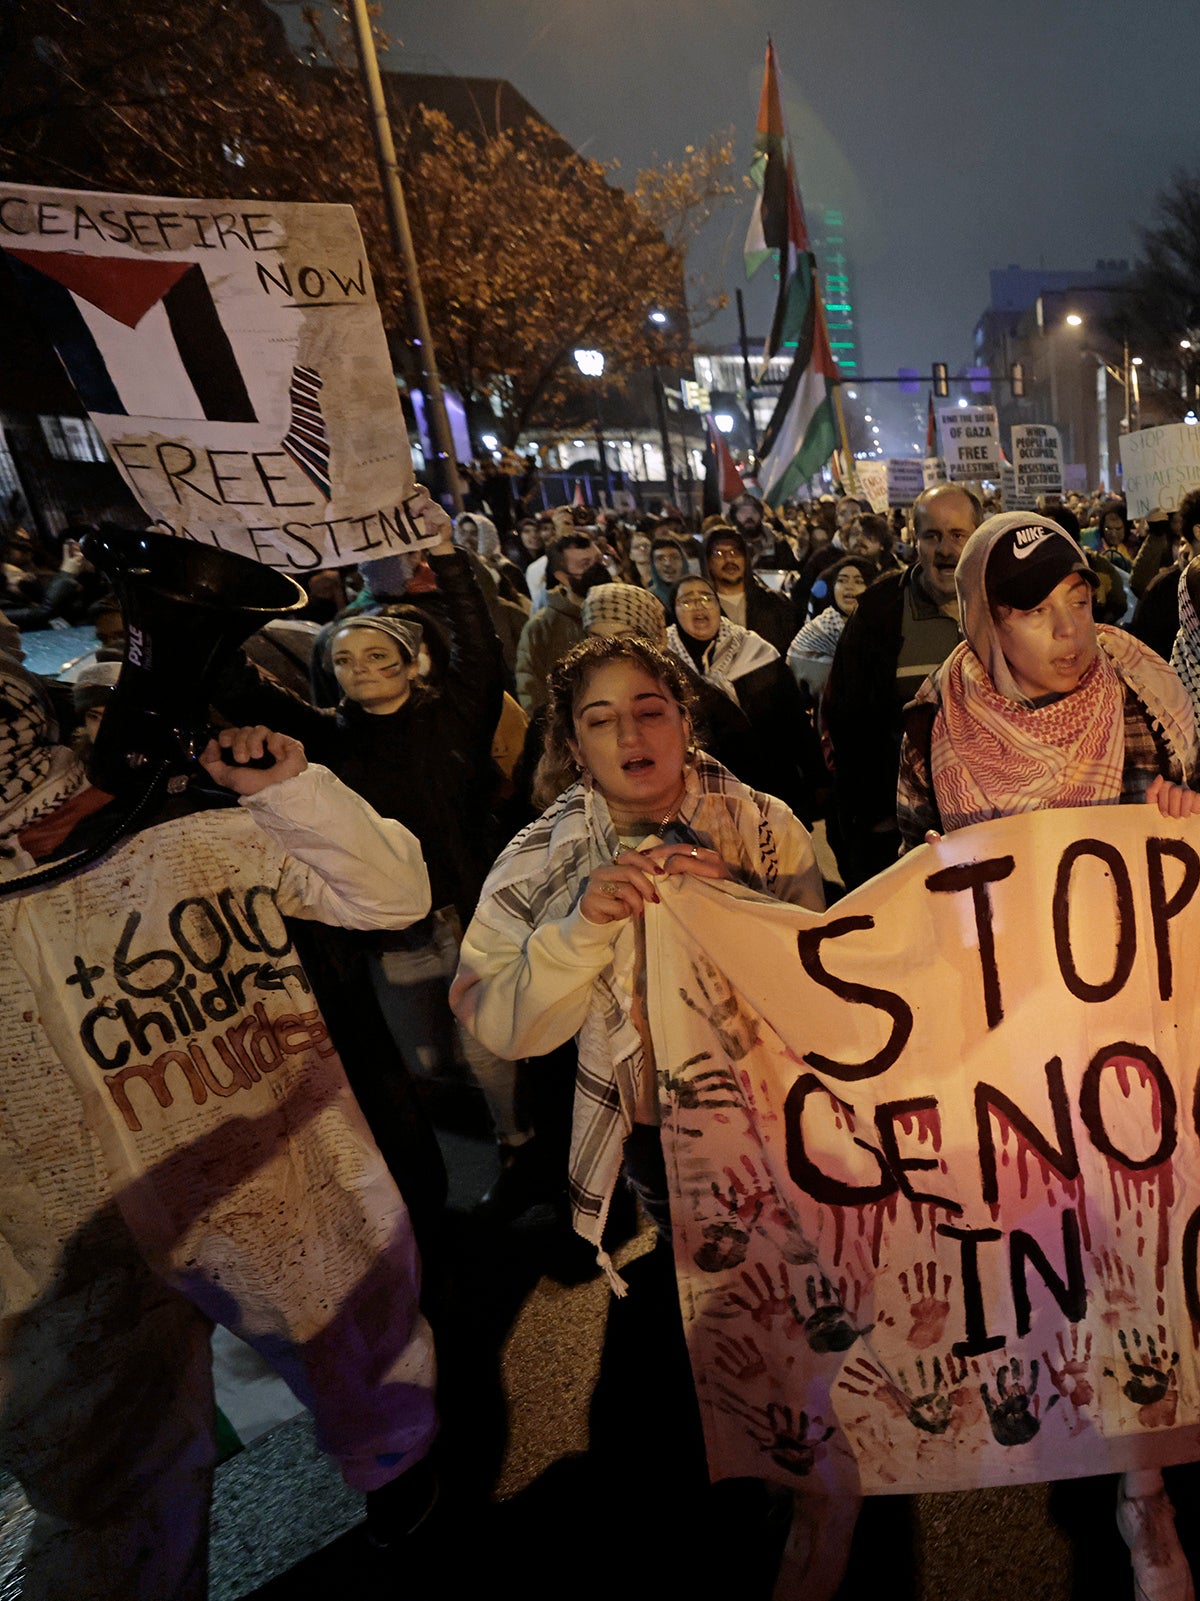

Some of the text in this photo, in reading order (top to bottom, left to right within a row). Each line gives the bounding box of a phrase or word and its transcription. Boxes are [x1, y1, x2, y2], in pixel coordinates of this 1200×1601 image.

[0, 199, 289, 251] CEASEFIRE
[256, 259, 367, 298] NOW
[950, 426, 992, 438] OF GAZA
[958, 445, 989, 460] FREE
[112, 442, 316, 508] FREE
[1016, 526, 1045, 546] NIKE
[128, 624, 144, 667] PYLE
[798, 836, 1200, 1082] STOP
[936, 1207, 1088, 1360] IN
